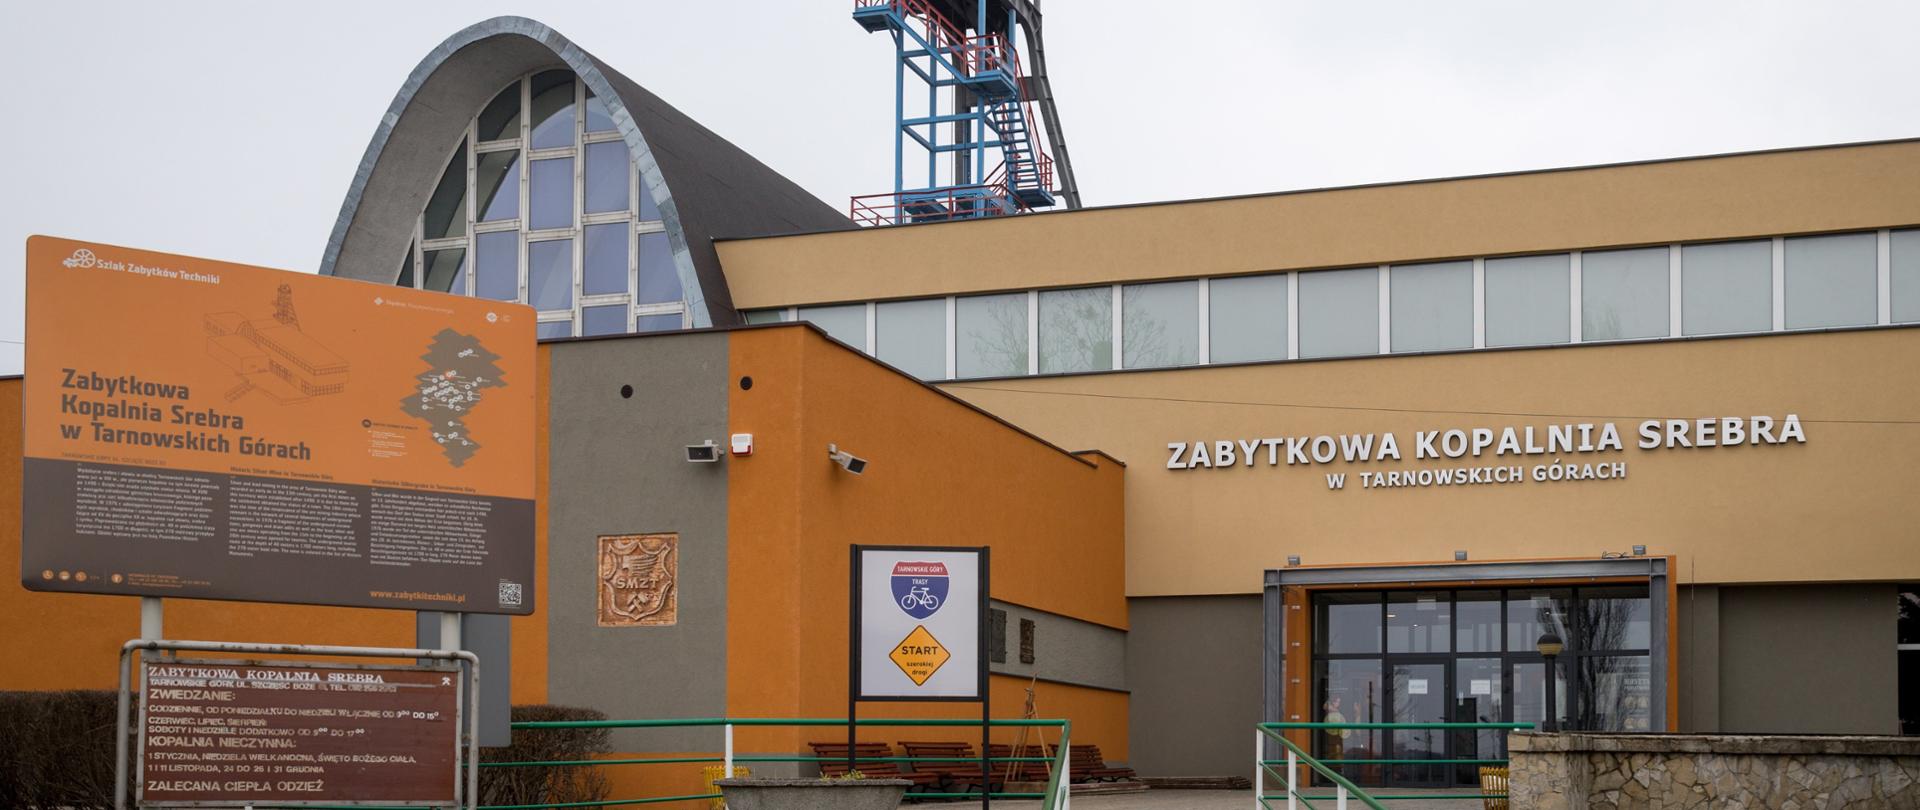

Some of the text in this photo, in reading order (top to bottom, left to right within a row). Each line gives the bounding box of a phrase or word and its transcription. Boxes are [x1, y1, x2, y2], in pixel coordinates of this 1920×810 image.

[97, 259, 220, 284] Szlak Zabytków Techniki
[61, 368, 189, 400] Zabytkowa
[61, 393, 244, 430] Kopalnia Srebra
[60, 422, 311, 461] w Tarnowskich Górach
[1167, 414, 1806, 469] ZABYTKOWA KOPALNIA SREBRA
[1326, 458, 1626, 489] W TARNOWSKICH GÓRACH
[897, 565, 944, 573] TARNOWSKIE GÓRY
[616, 578, 659, 589] SMZT
[370, 590, 466, 603] www.zabytkitechniki.pl
[901, 646, 938, 655] START
[148, 666, 384, 684] ZABYTKOWA KOPALNIA SREBRA
[150, 688, 236, 700] ZWIEDZANIE:
[149, 704, 205, 715] CODZIENNIE,
[284, 708, 297, 716] DO
[412, 710, 425, 719] DO
[148, 725, 187, 734] SOBOTY
[239, 728, 296, 736] DODATKOWO
[331, 729, 344, 737] DO
[149, 736, 297, 748] KOPALNIA NIECZYNNA:
[154, 752, 200, 761] STYCZNIA,
[202, 753, 247, 761] NIEDZIELA
[168, 764, 221, 773] LISTOPADA,
[286, 765, 324, 773] GRUDNIA
[148, 779, 324, 792] ZALECANA CIEPŁA ODZIEŻ
